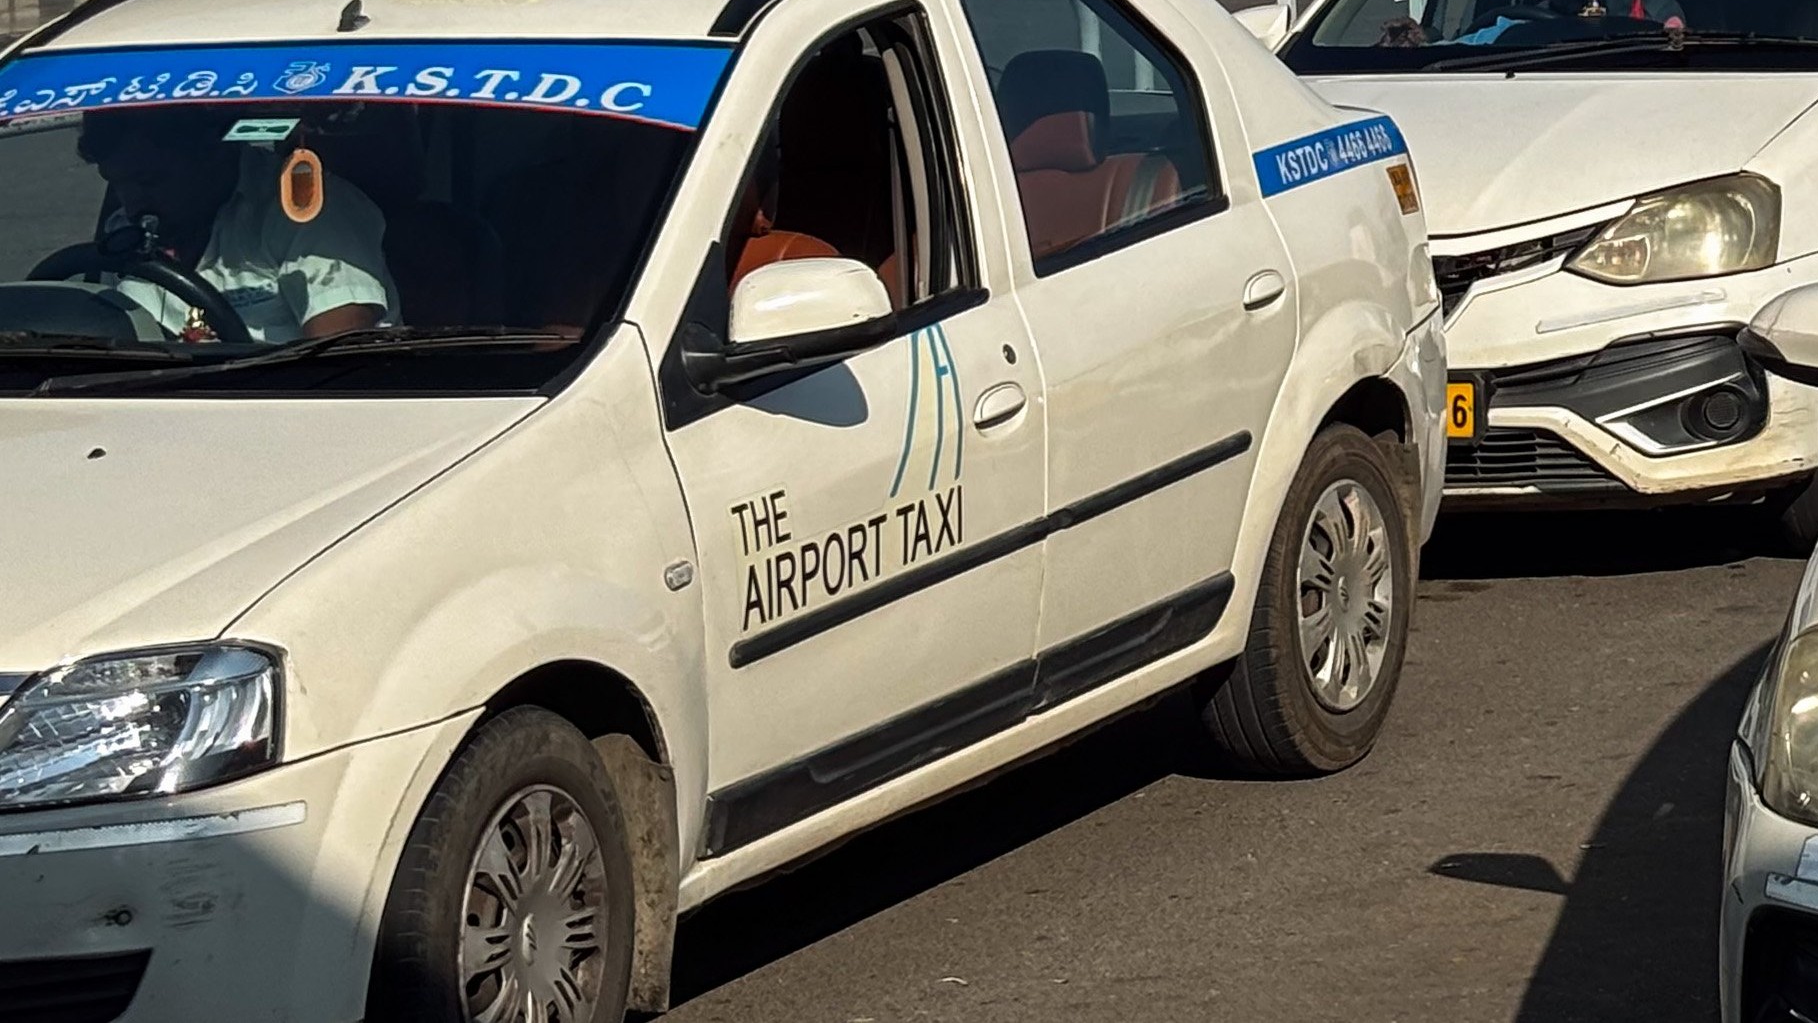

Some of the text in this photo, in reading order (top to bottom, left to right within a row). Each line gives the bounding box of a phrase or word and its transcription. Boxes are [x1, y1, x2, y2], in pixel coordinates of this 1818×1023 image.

[332, 66, 652, 112] K.S.T.D.C
[1275, 141, 1330, 185] KSTDC
[731, 489, 792, 557] THE
[742, 484, 963, 632] AIRPORT TAXI
